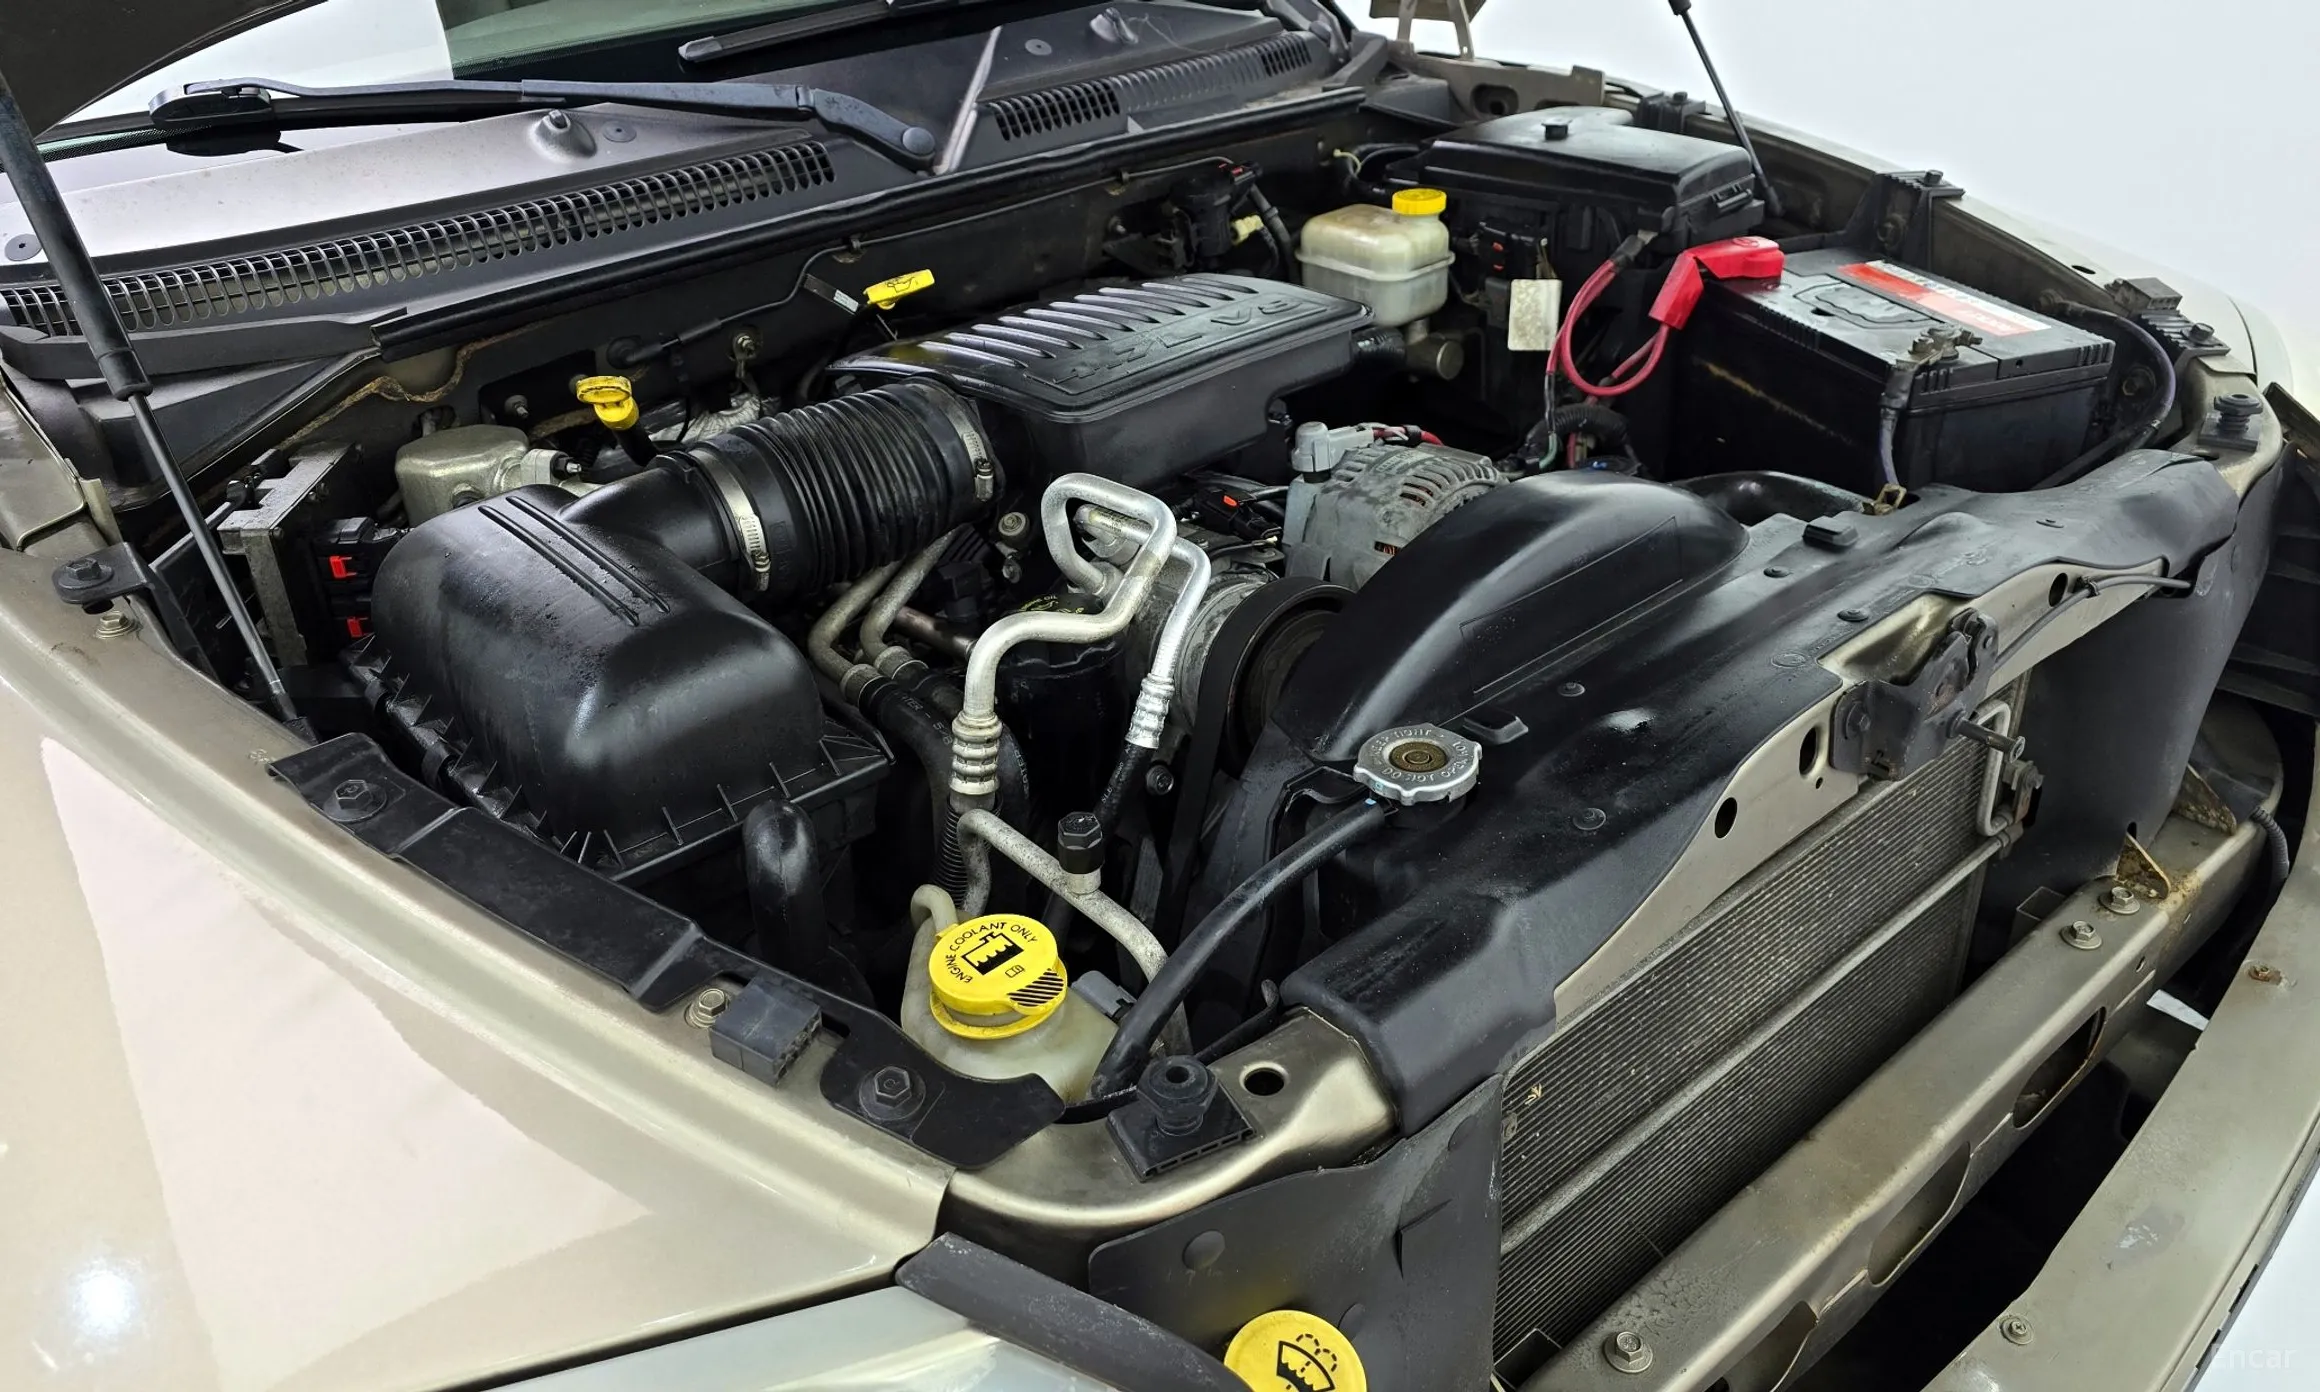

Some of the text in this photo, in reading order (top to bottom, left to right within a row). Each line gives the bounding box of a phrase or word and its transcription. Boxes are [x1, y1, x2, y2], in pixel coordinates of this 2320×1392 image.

[1381, 768, 1402, 779] DO
[945, 922, 1038, 983] ENGINE COOLANT ONLY
